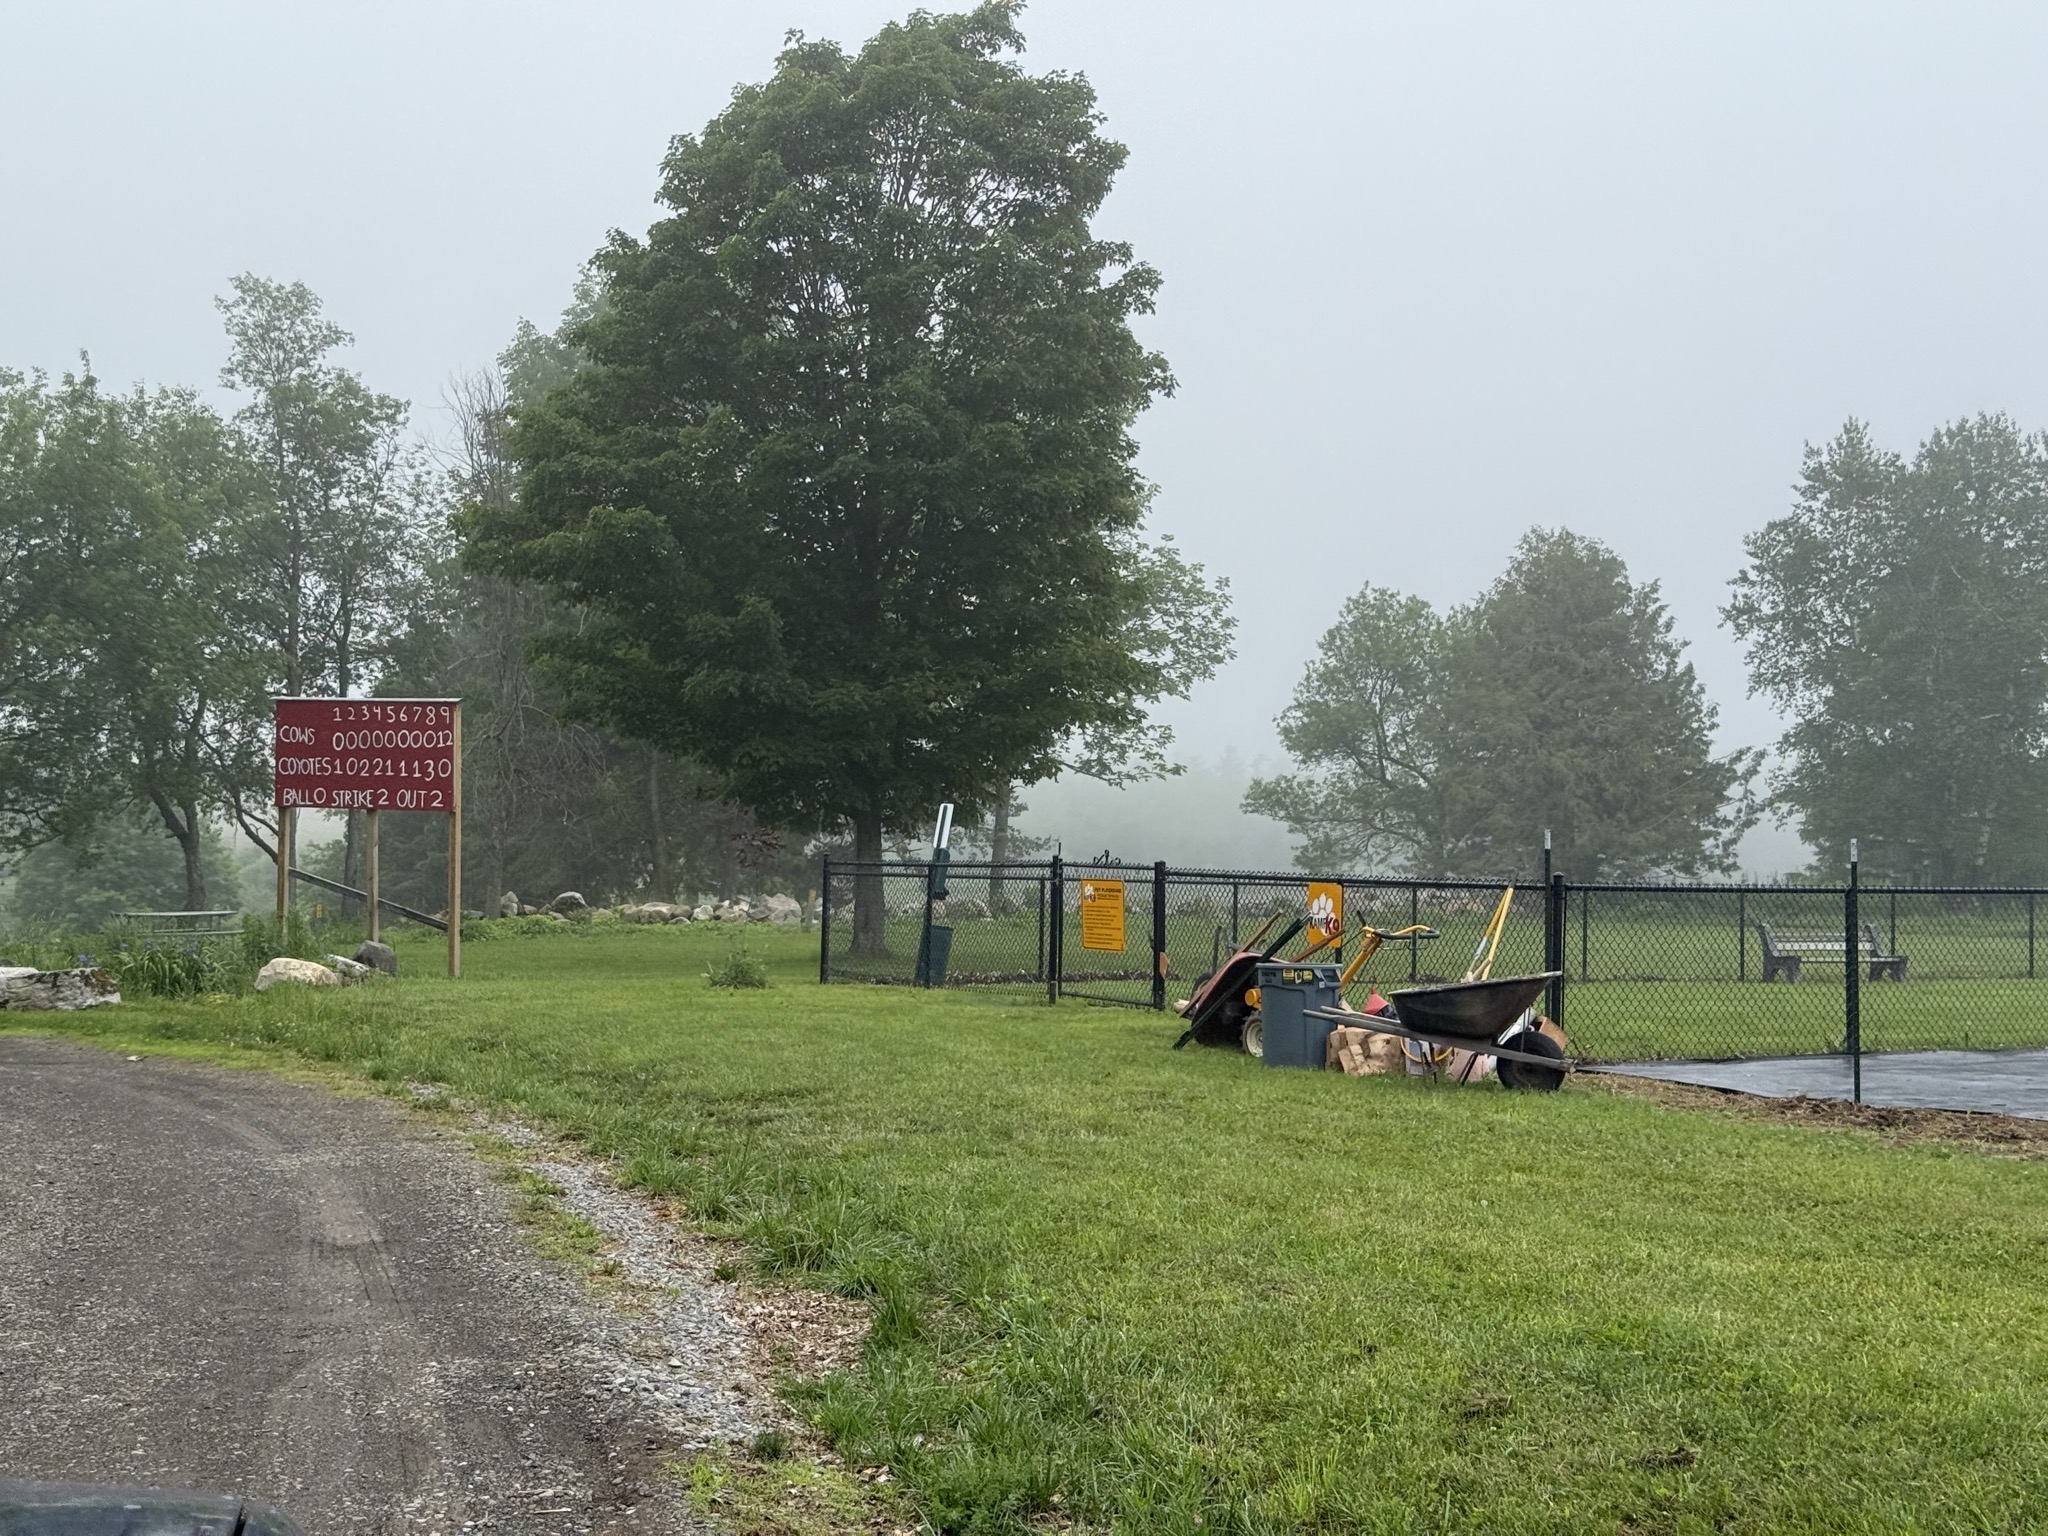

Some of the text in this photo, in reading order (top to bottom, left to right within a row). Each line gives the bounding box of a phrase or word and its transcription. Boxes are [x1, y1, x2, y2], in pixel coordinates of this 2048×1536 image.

[279, 725, 315, 745] COWS
[279, 757, 331, 775] COYOTES
[331, 789, 374, 807] STRIKE
[376, 788, 389, 804] 2
[396, 789, 427, 807] OUT
[429, 789, 443, 806] 2
